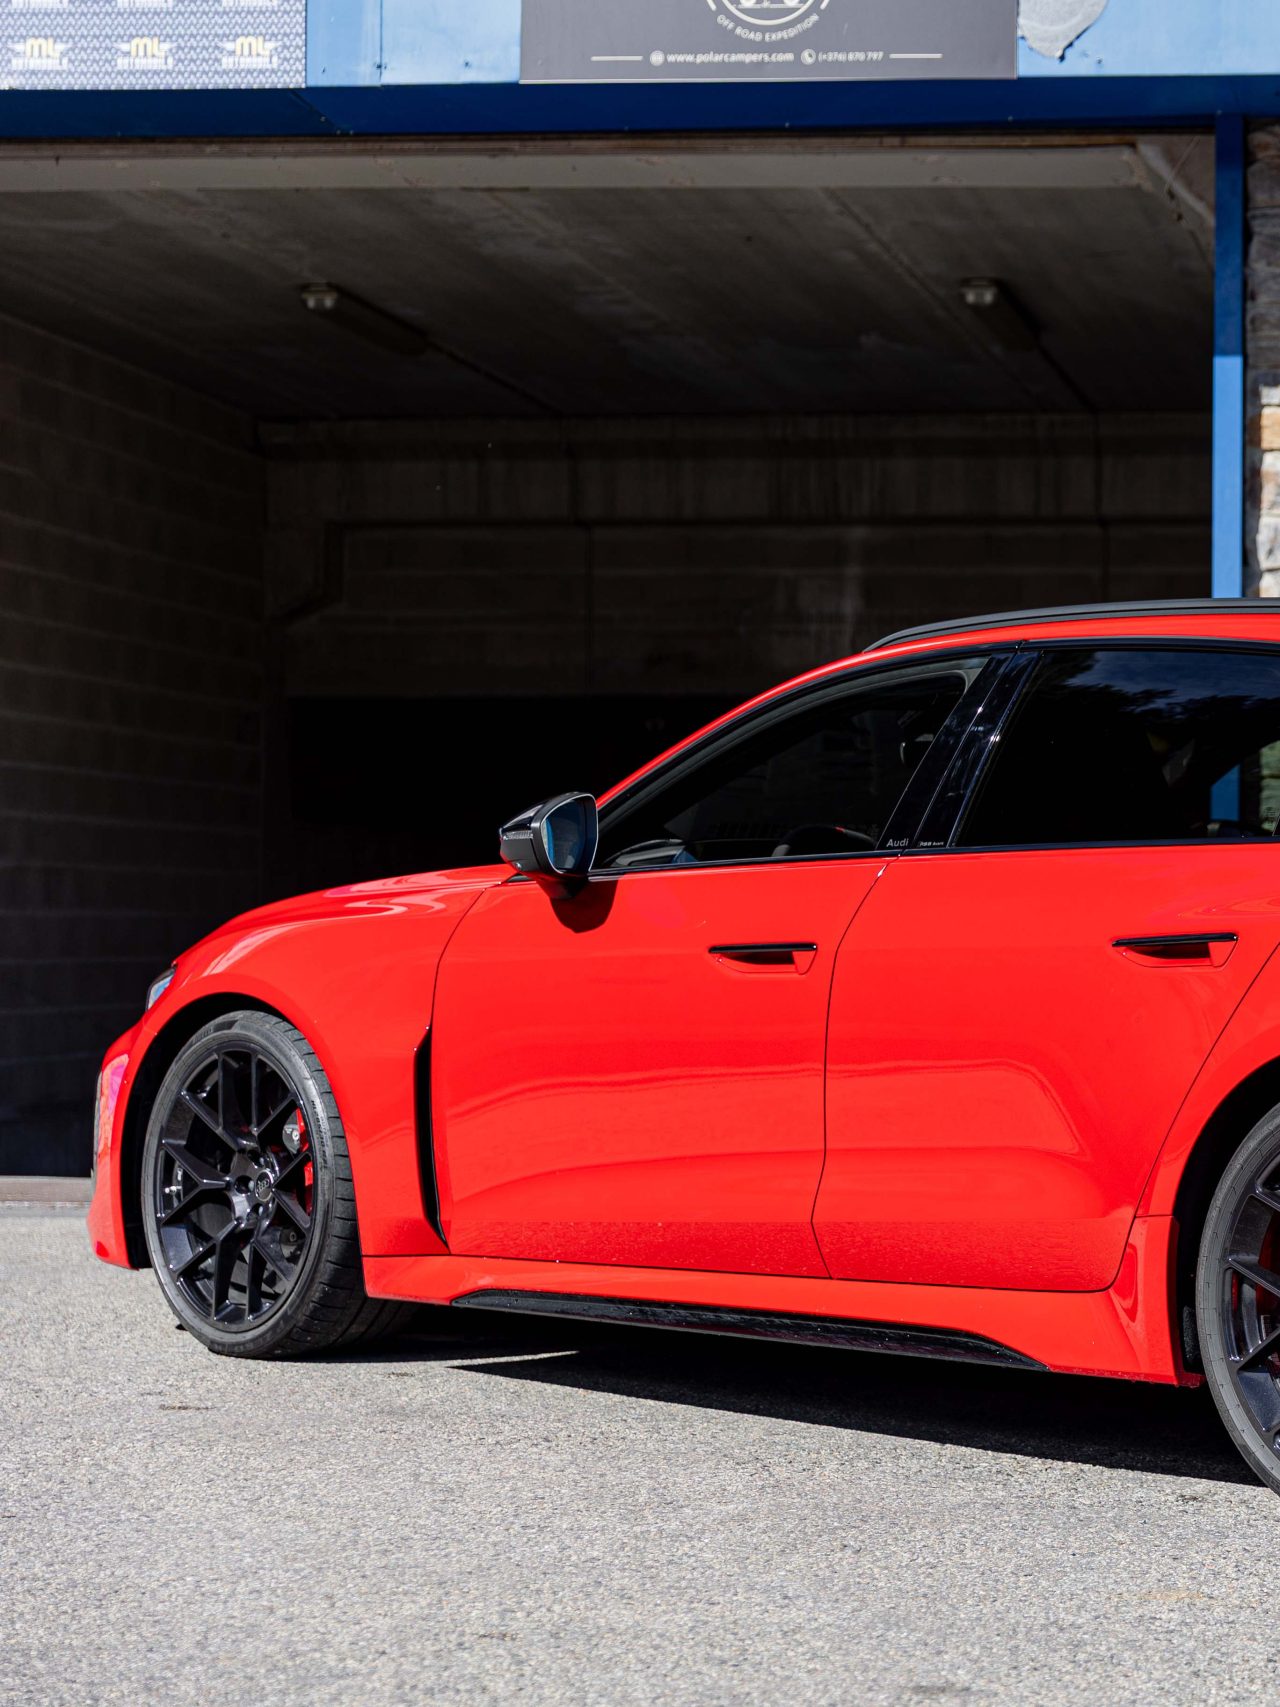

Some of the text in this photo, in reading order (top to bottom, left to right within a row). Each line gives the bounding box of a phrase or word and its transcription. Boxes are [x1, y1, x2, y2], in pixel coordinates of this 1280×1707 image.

[717, 13, 820, 42] OFF ROAD EXPEDITION
[667, 50, 794, 64] www.polarcampers.com
[886, 838, 909, 847] Audi
